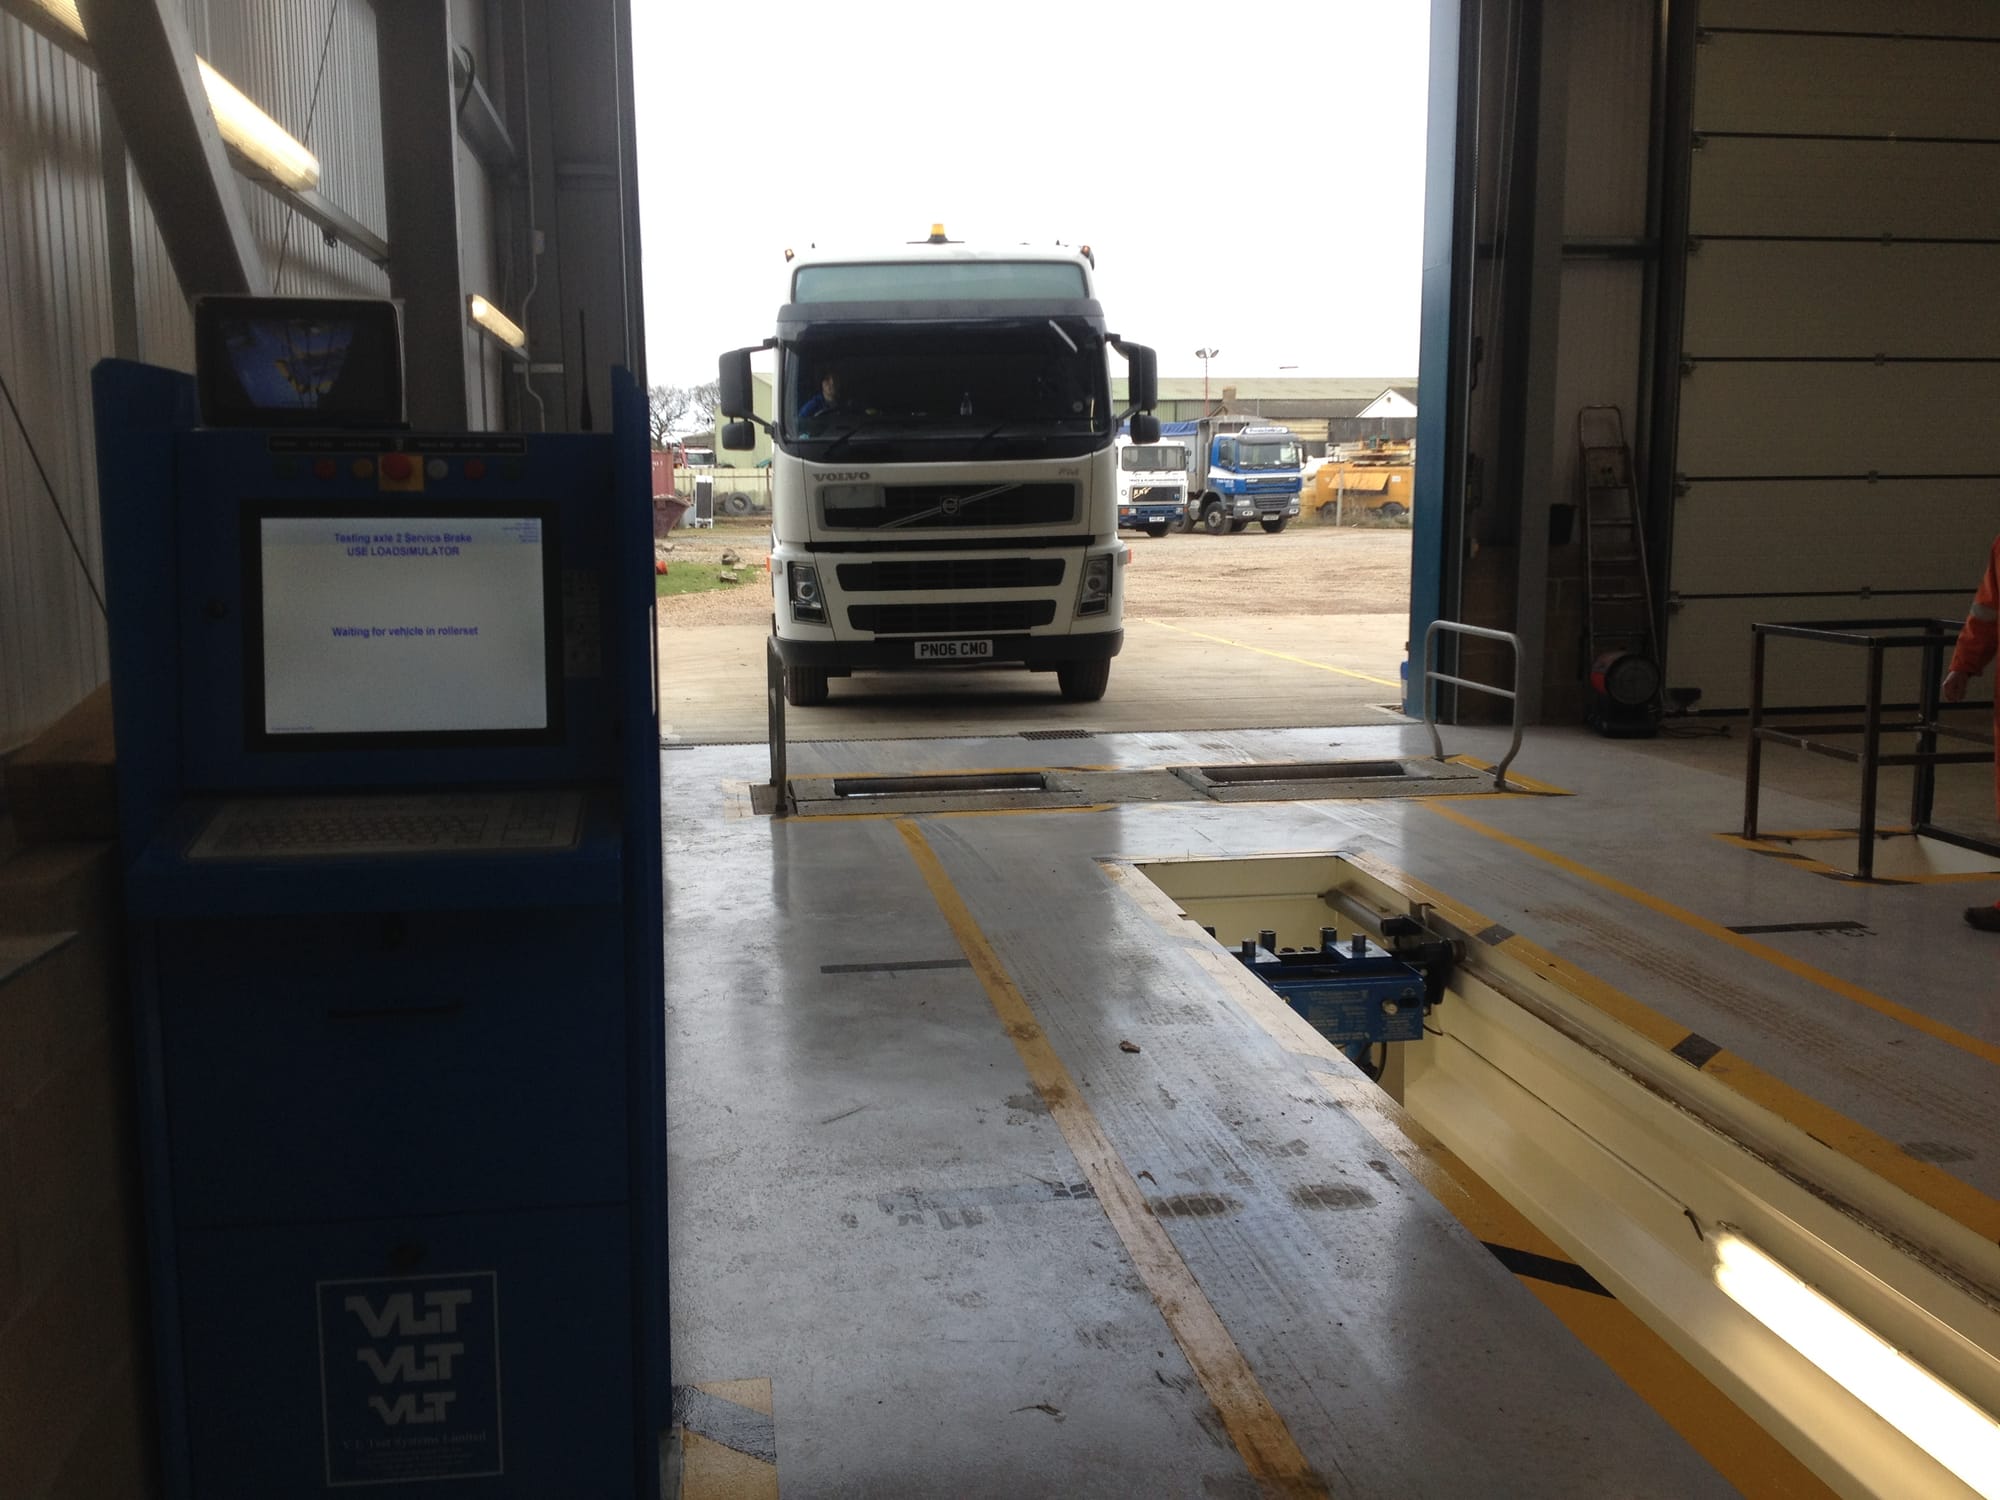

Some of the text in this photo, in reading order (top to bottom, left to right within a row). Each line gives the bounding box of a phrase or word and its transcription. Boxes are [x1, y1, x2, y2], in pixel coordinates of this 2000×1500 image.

[813, 472, 870, 481] VOLVO
[335, 533, 370, 544] Testing
[373, 534, 393, 542] axle
[404, 533, 441, 543] Service
[443, 533, 472, 543] Brake
[347, 546, 460, 556] USE LOADSIMULATOR
[332, 625, 478, 638] Waiting for vehicle in rollerset
[920, 642, 957, 657] PN06
[345, 1289, 472, 1339] VLT
[356, 1343, 464, 1385] VLT
[368, 1391, 456, 1426] VLT
